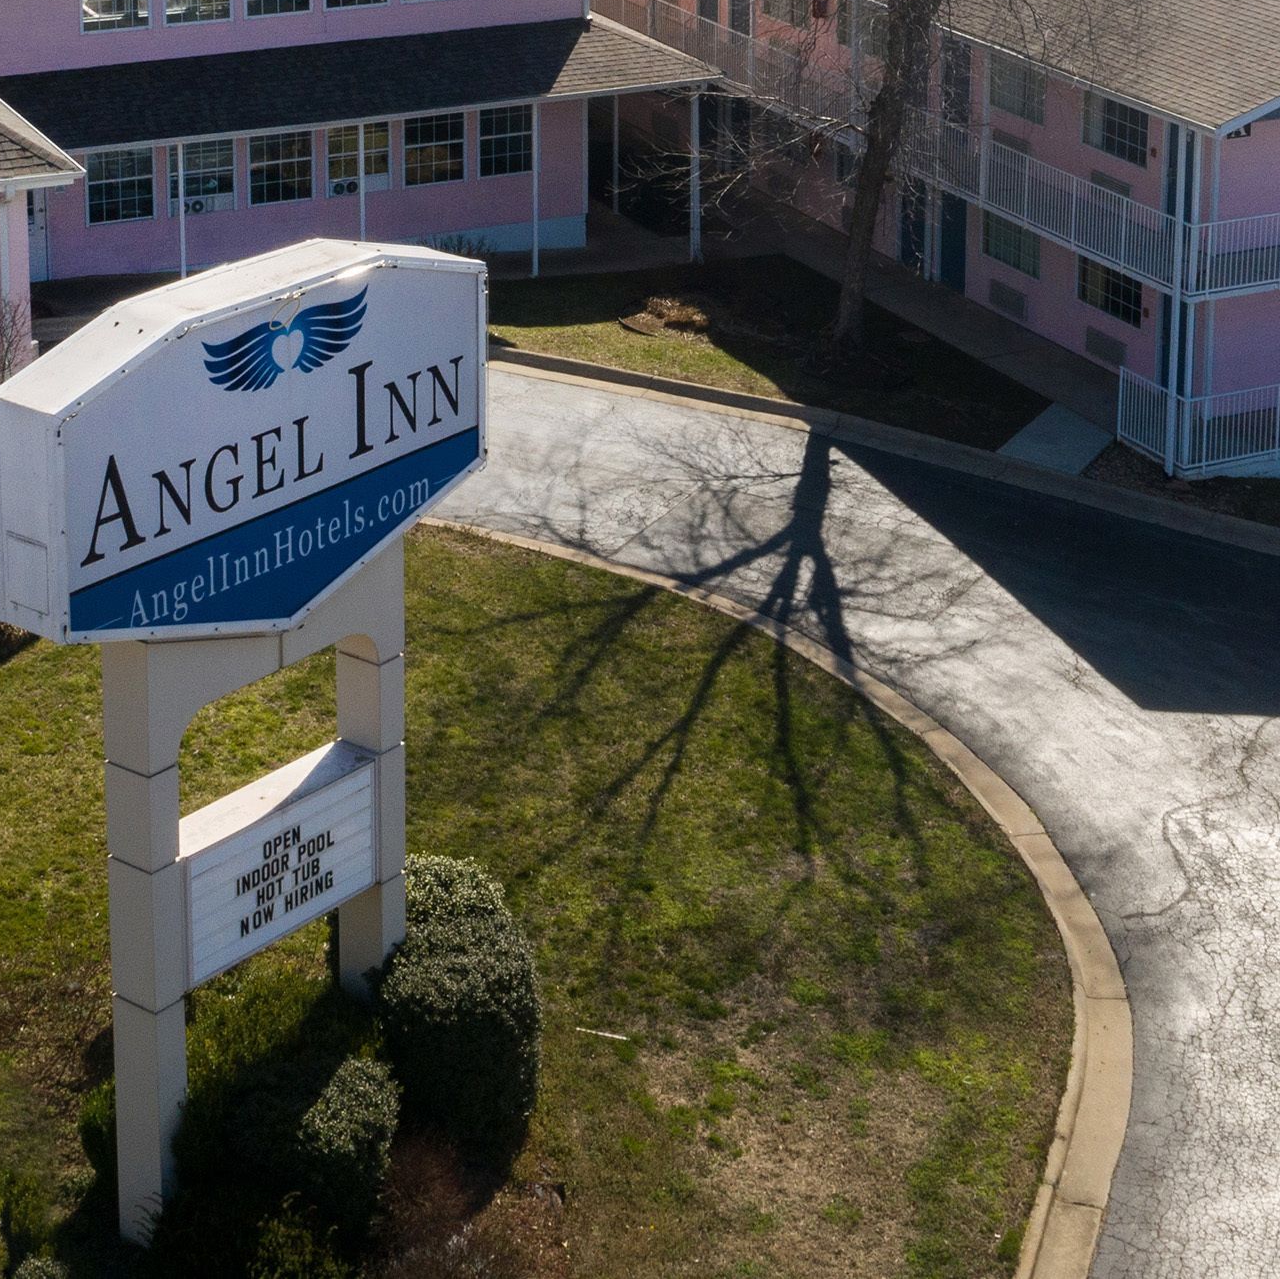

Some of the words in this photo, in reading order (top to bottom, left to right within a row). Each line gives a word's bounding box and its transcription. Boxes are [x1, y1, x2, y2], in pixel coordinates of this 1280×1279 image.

[80, 415, 324, 569] ANGEL
[348, 355, 464, 460] INN
[128, 475, 431, 629] AngelInnHotels.com
[236, 854, 290, 897] INDOOR
[297, 830, 335, 864] POOL
[263, 825, 301, 859] OPEN
[240, 903, 275, 938] NOW
[284, 871, 334, 913] HIRING
[256, 876, 285, 907] HOT
[292, 857, 320, 887] TUB
